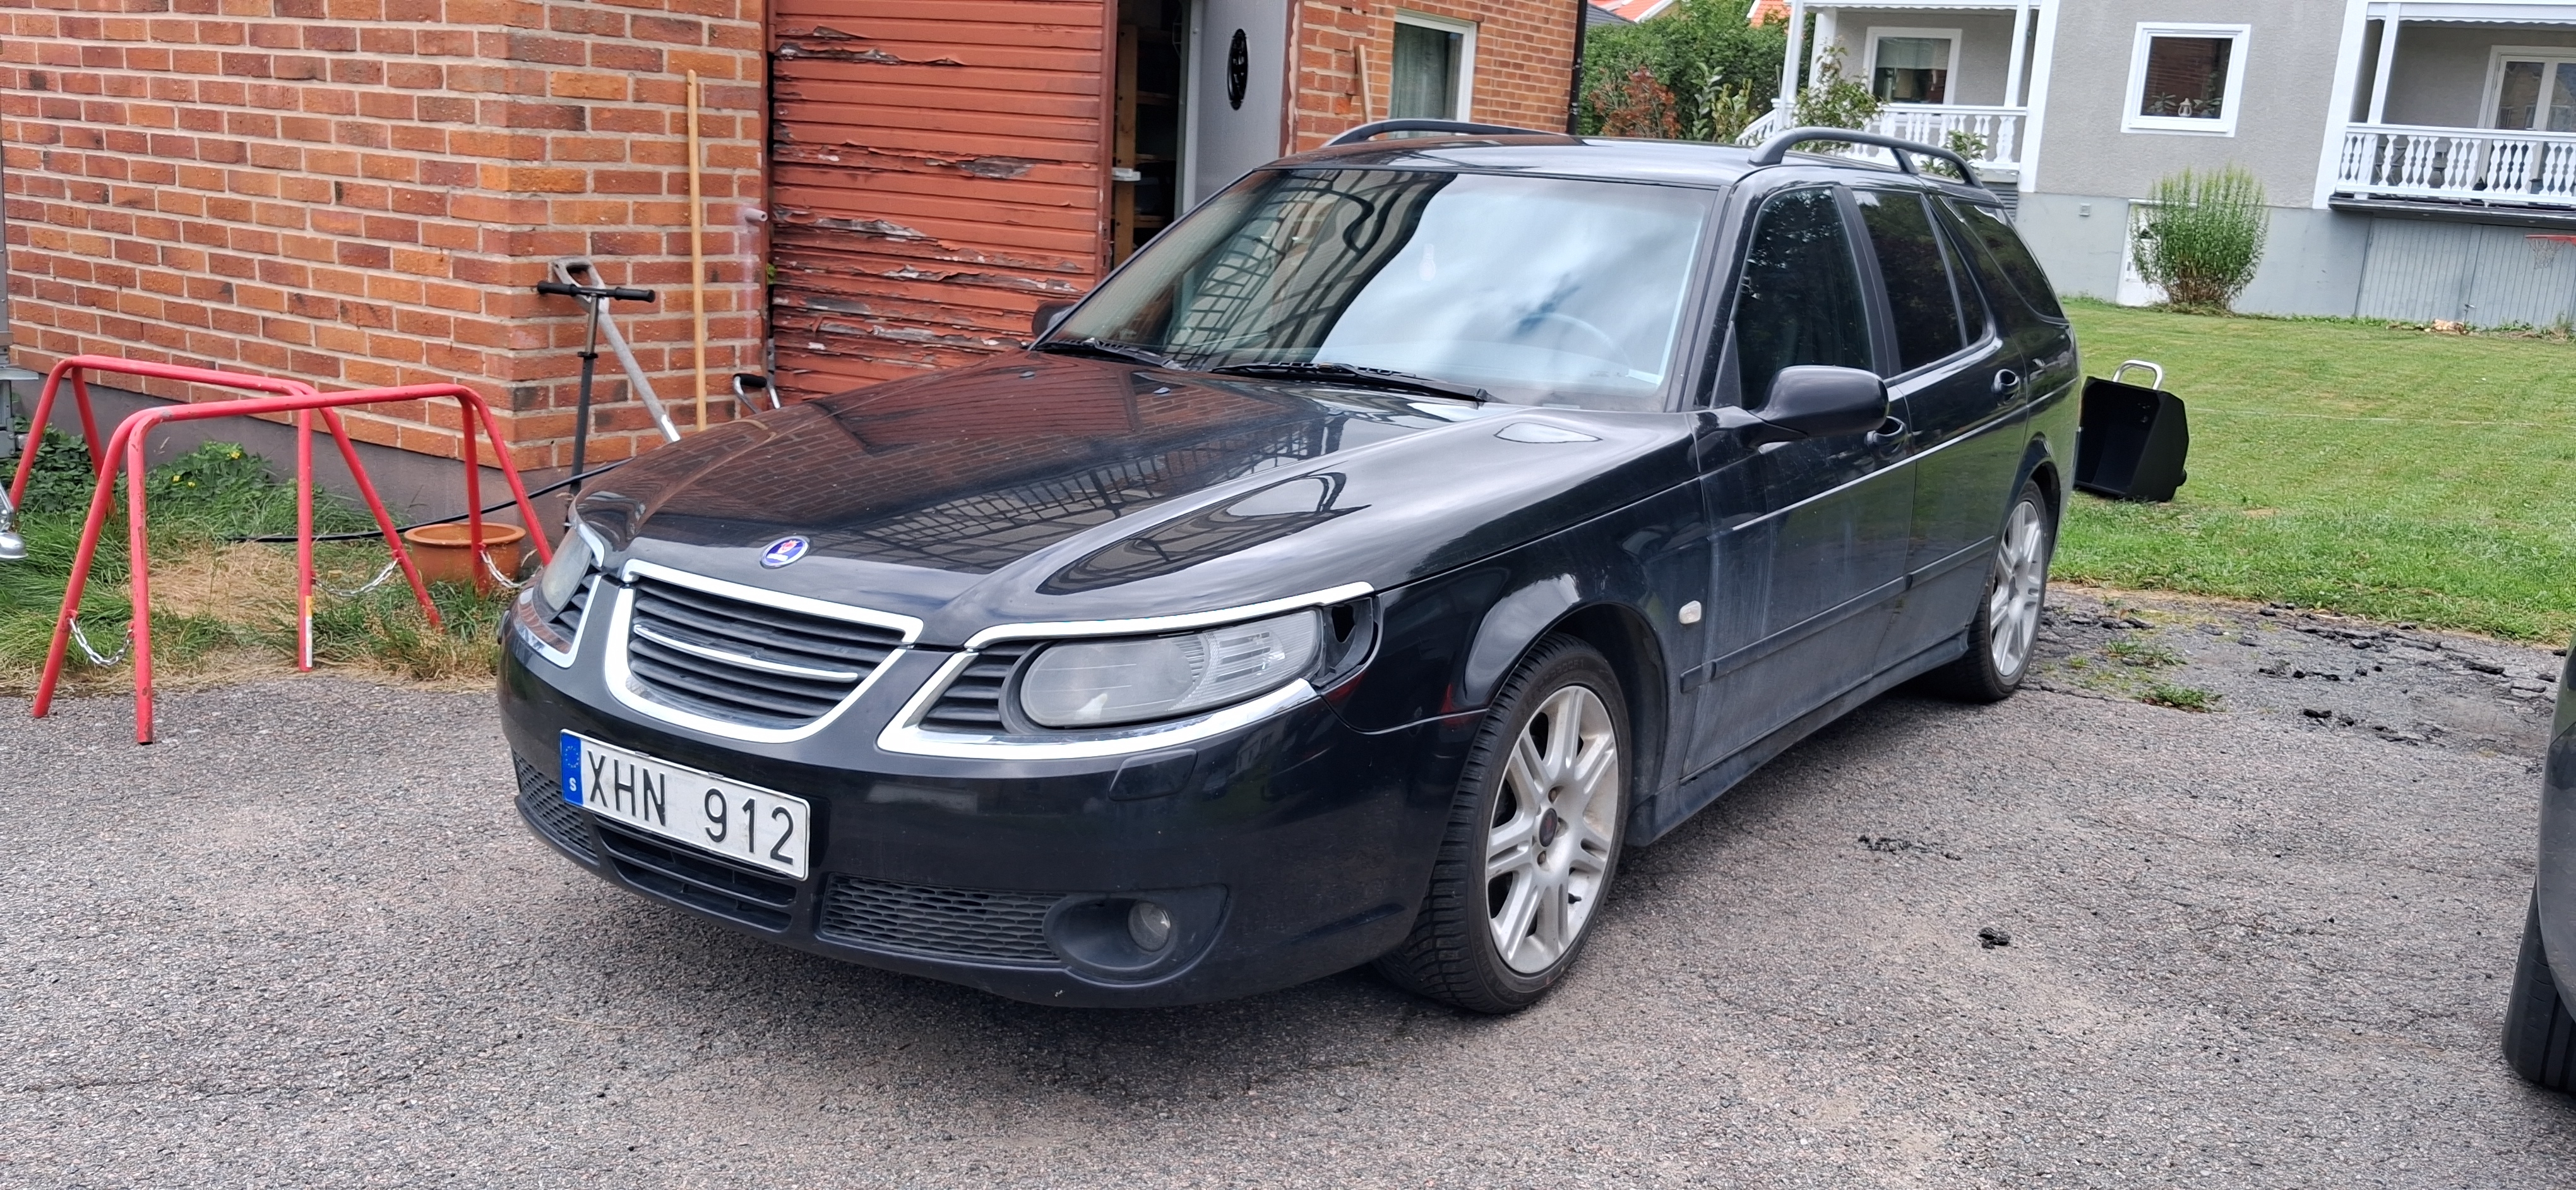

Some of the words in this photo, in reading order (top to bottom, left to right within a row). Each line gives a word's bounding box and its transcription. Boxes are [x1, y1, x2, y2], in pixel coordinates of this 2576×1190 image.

[569, 777, 577, 791] S
[587, 750, 667, 827] XHN
[704, 788, 794, 865] 912
